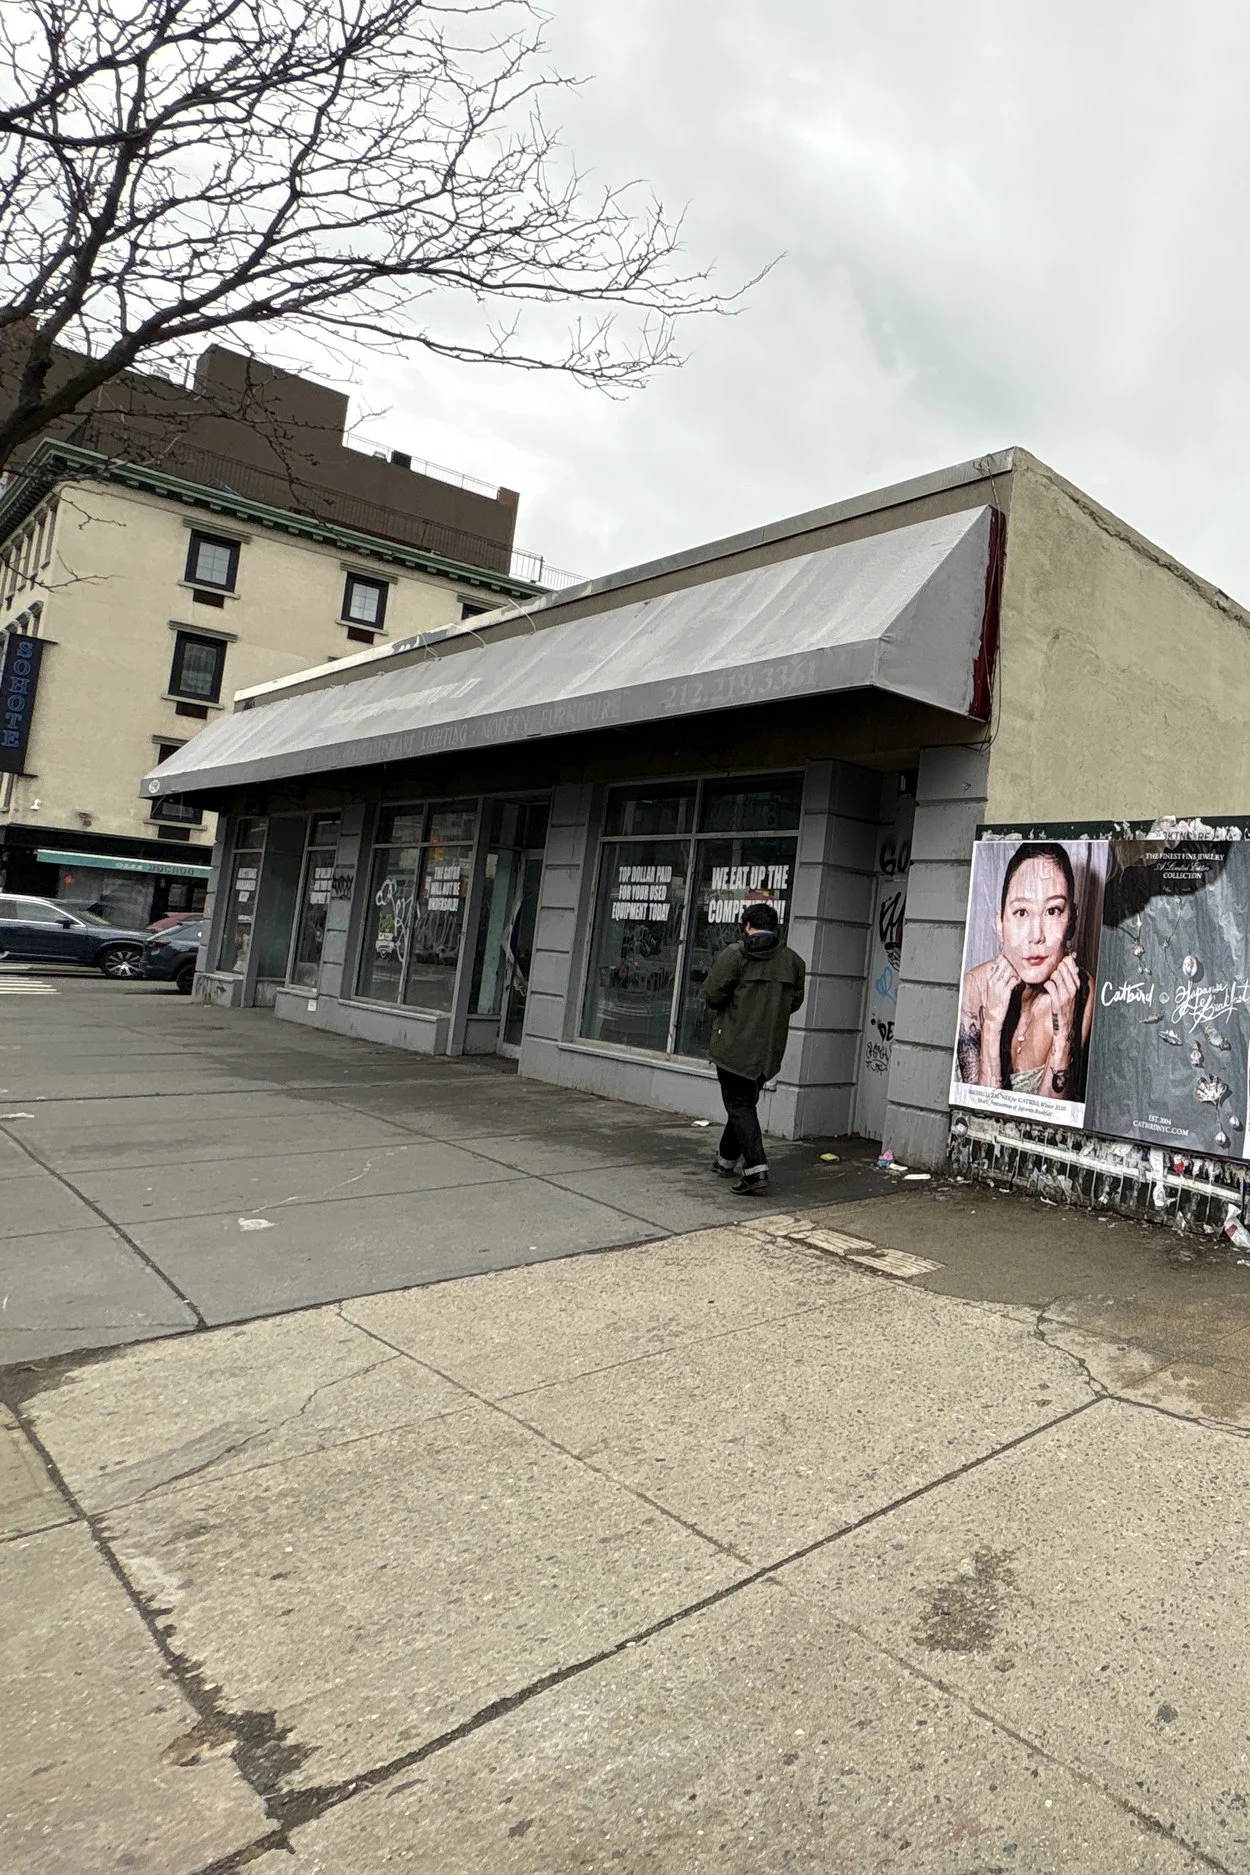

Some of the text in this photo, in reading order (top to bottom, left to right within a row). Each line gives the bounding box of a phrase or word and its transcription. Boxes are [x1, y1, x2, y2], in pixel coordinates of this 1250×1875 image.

[421, 723, 468, 749] LIGHTING
[1145, 852, 1160, 860] THE
[1197, 853, 1225, 861] JEWELRY
[619, 866, 672, 883] TOP DOLLAR PAID
[711, 865, 790, 890] WE EAT UP THE
[619, 885, 667, 900] FOR YOUR USED
[611, 901, 671, 921] EQUIPMENT TODAY
[1101, 980, 1155, 1007] Catbird
[1132, 1120, 1189, 1137] CATBIRDNYC.COM
